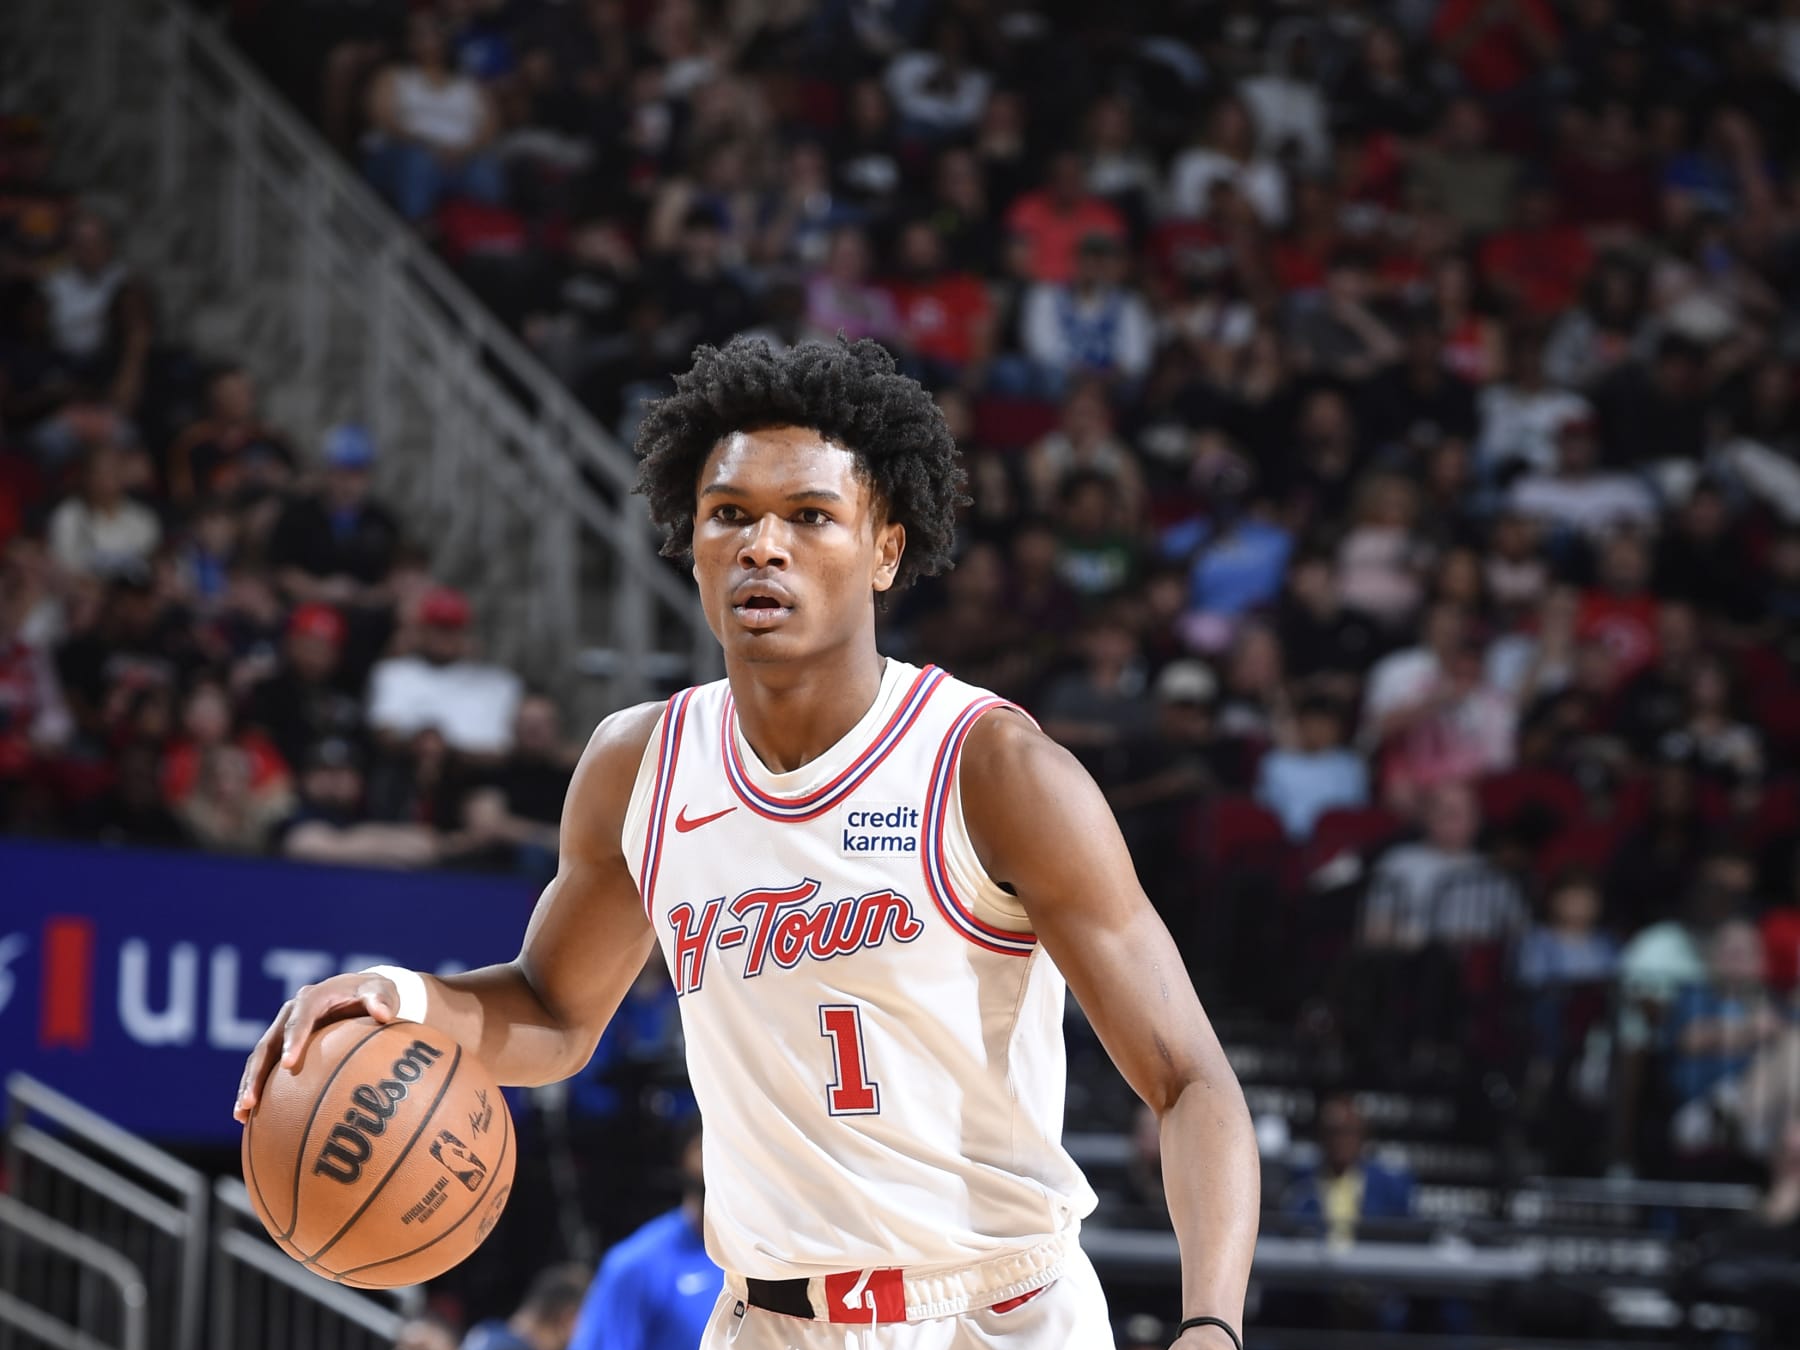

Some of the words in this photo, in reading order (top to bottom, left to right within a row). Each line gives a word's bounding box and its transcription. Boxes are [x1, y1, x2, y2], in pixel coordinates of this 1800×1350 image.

[843, 829, 917, 851] karma
[847, 806, 919, 828] credit
[668, 877, 924, 997] H-Town
[116, 937, 470, 1049] ULT
[311, 1039, 444, 1186] Wilson
[819, 1005, 880, 1116] 1
[401, 1201, 426, 1225] OFFICIAL
[421, 1188, 439, 1206] GAME
[434, 1176, 449, 1192] BALL
